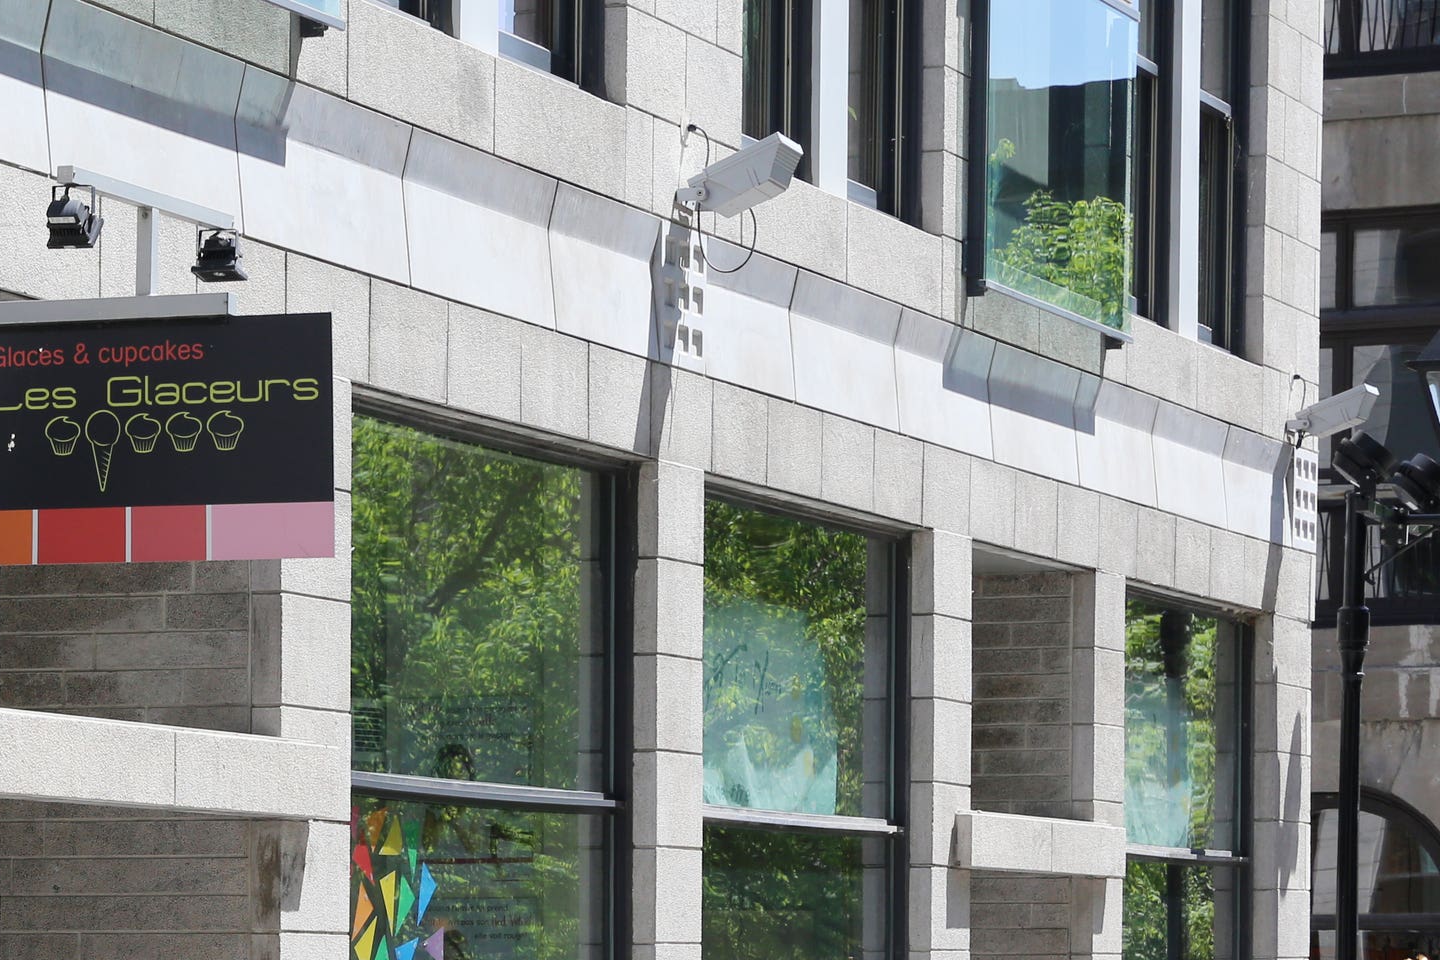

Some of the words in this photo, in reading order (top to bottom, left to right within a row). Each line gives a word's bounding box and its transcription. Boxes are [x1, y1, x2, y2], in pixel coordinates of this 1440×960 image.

[73, 342, 91, 365] &
[98, 339, 204, 367] cupcakes
[107, 375, 319, 407] Glaceurs
